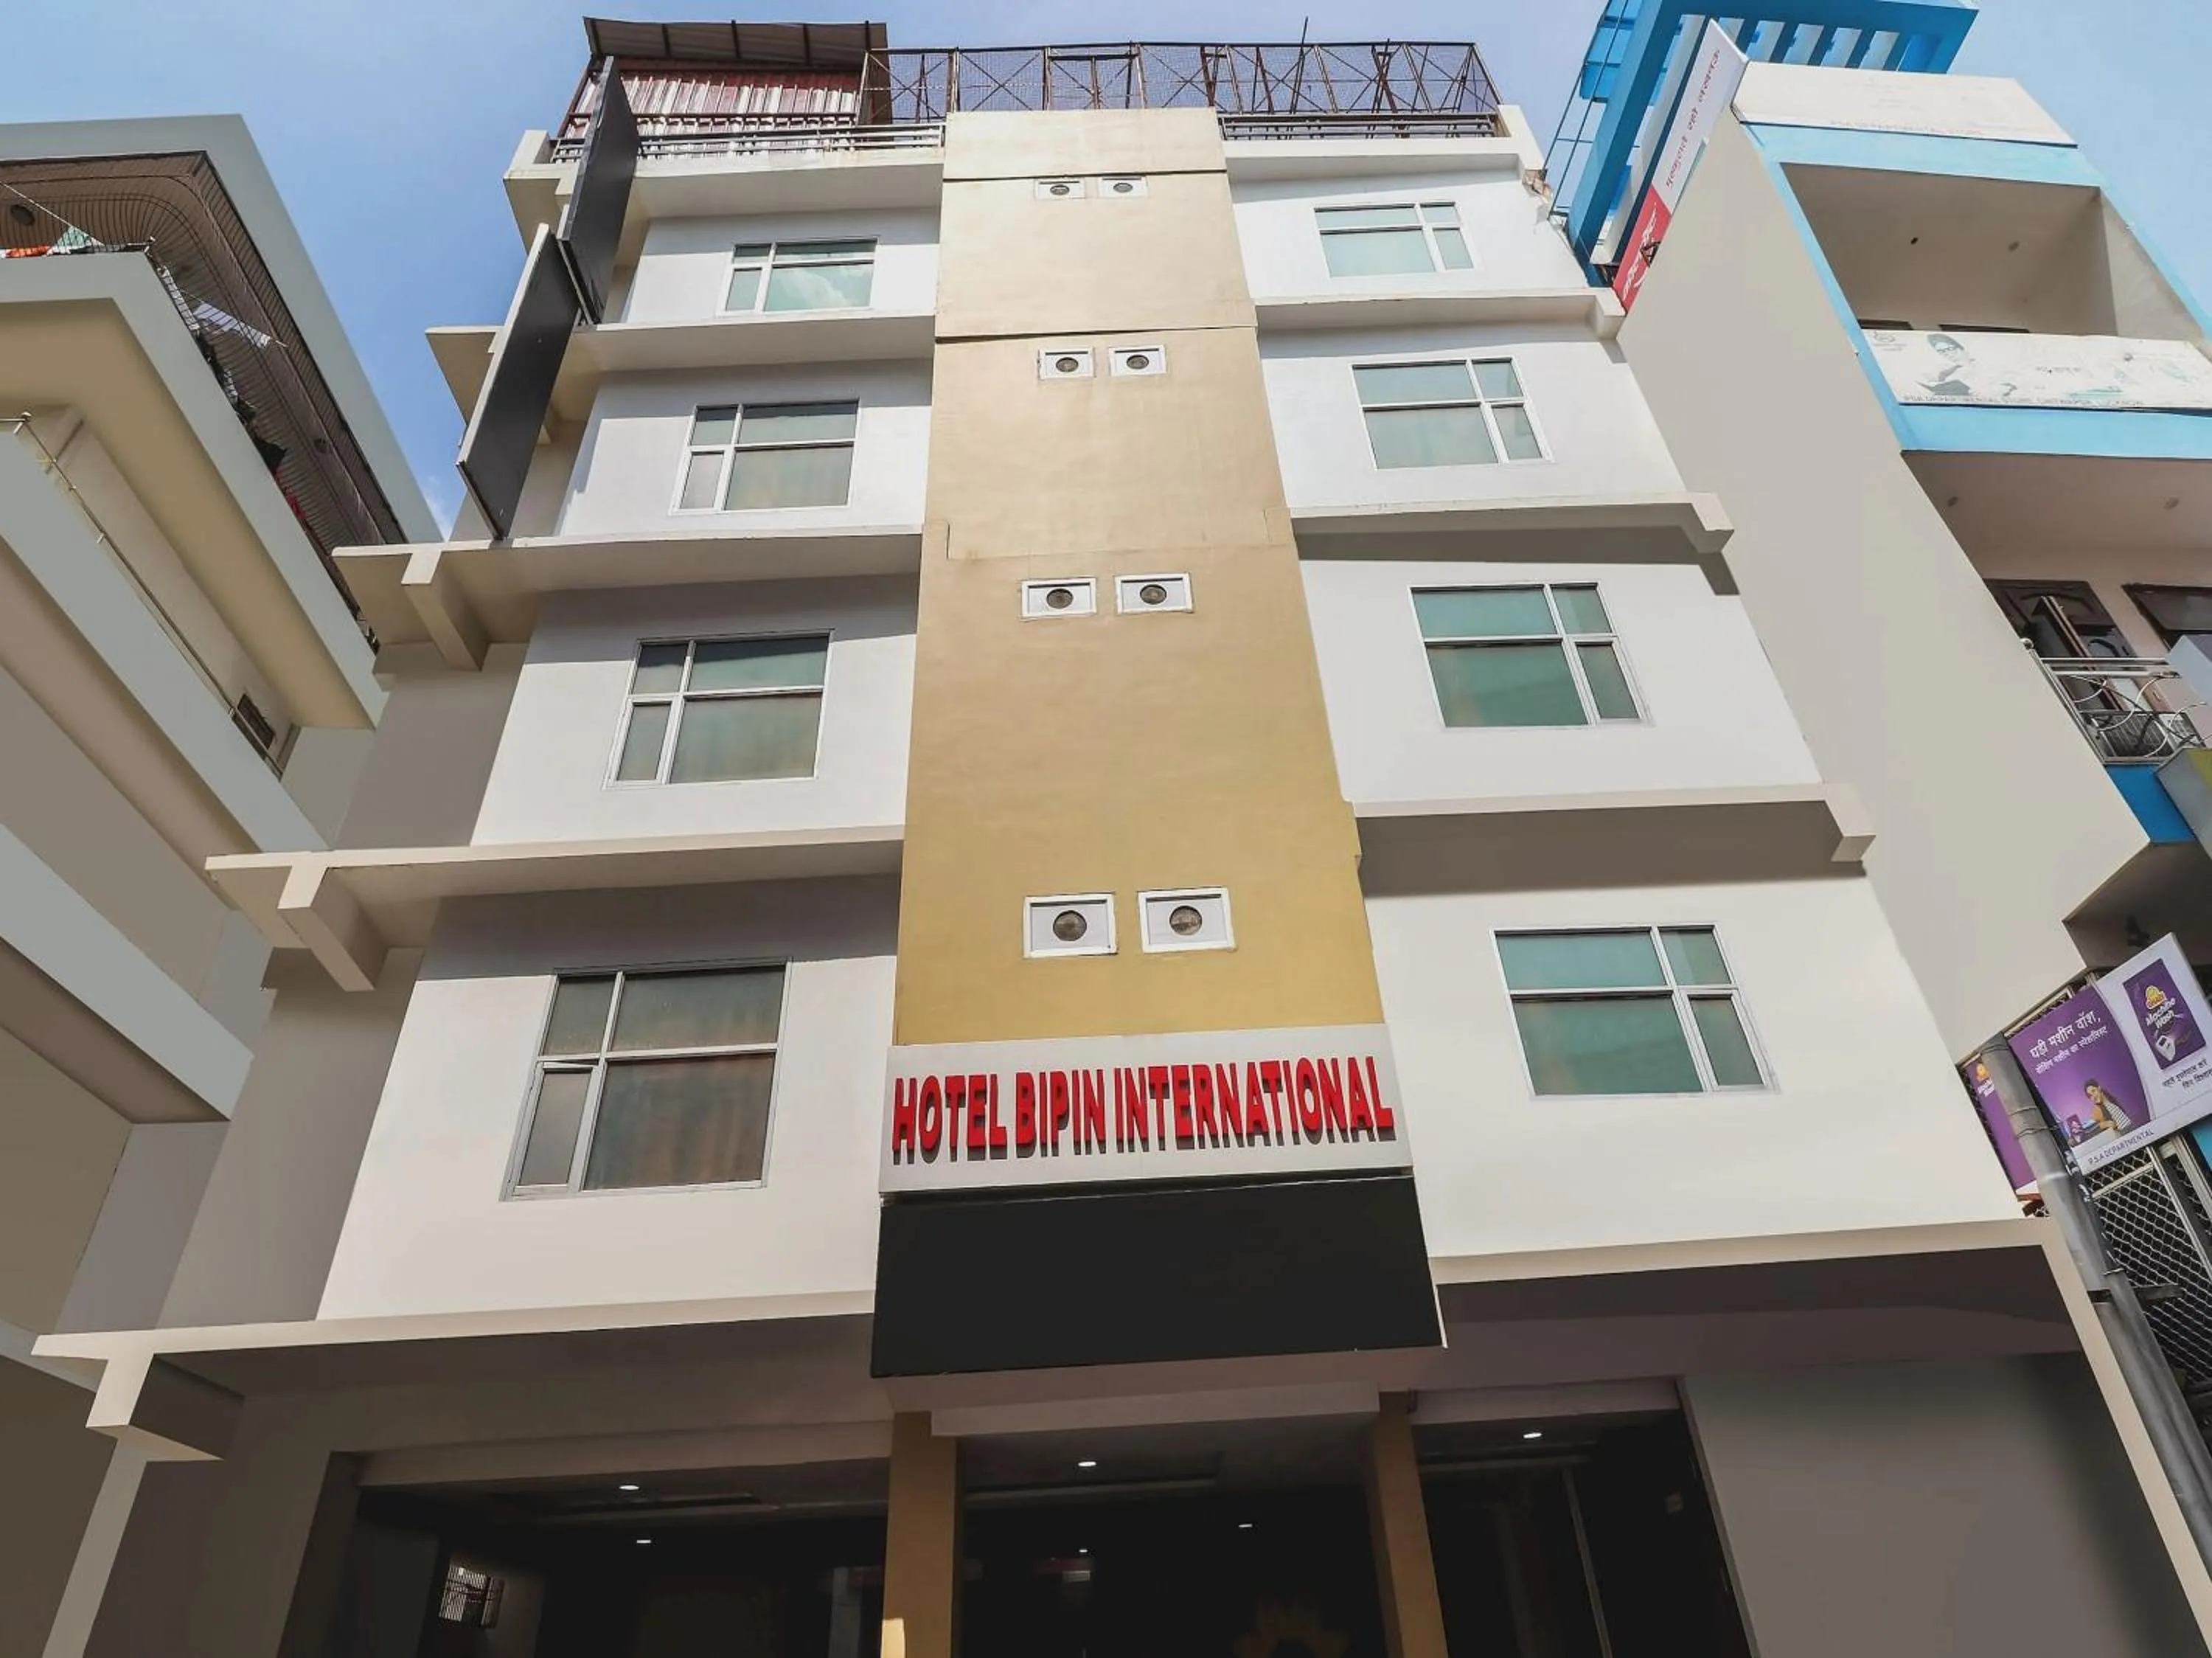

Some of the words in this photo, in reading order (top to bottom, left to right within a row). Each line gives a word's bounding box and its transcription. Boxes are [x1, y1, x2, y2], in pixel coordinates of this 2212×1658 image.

[2048, 1025, 2076, 1046] मशीन
[891, 1073, 1008, 1152] HOTEL
[1015, 1068, 1106, 1147] BIPIN
[1113, 1055, 1394, 1142] INTERNATIONAL
